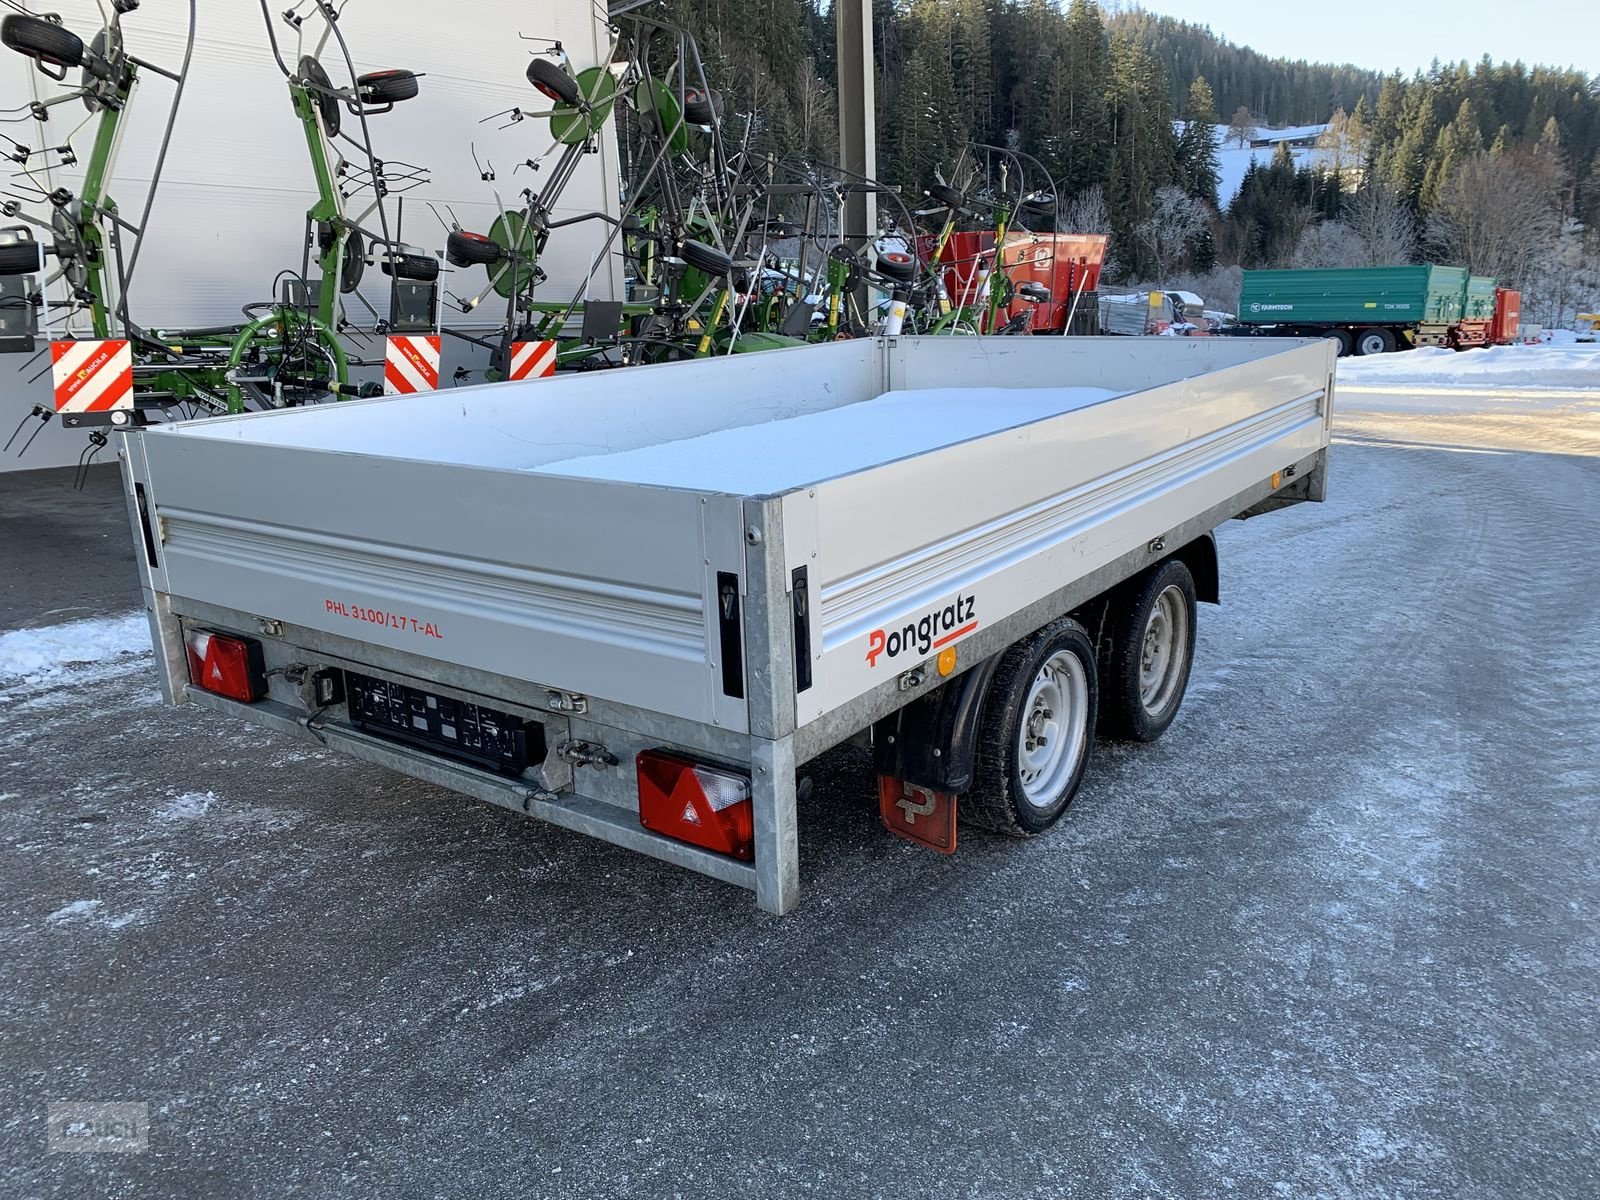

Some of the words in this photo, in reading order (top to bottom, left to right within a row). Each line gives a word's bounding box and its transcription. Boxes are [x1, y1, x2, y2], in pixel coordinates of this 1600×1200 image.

[200, 392, 227, 409] TWSTER
[325, 599, 349, 616] PHL
[352, 605, 407, 630] 3100/17
[410, 618, 443, 639] T-AL
[865, 593, 975, 668] Pongratz
